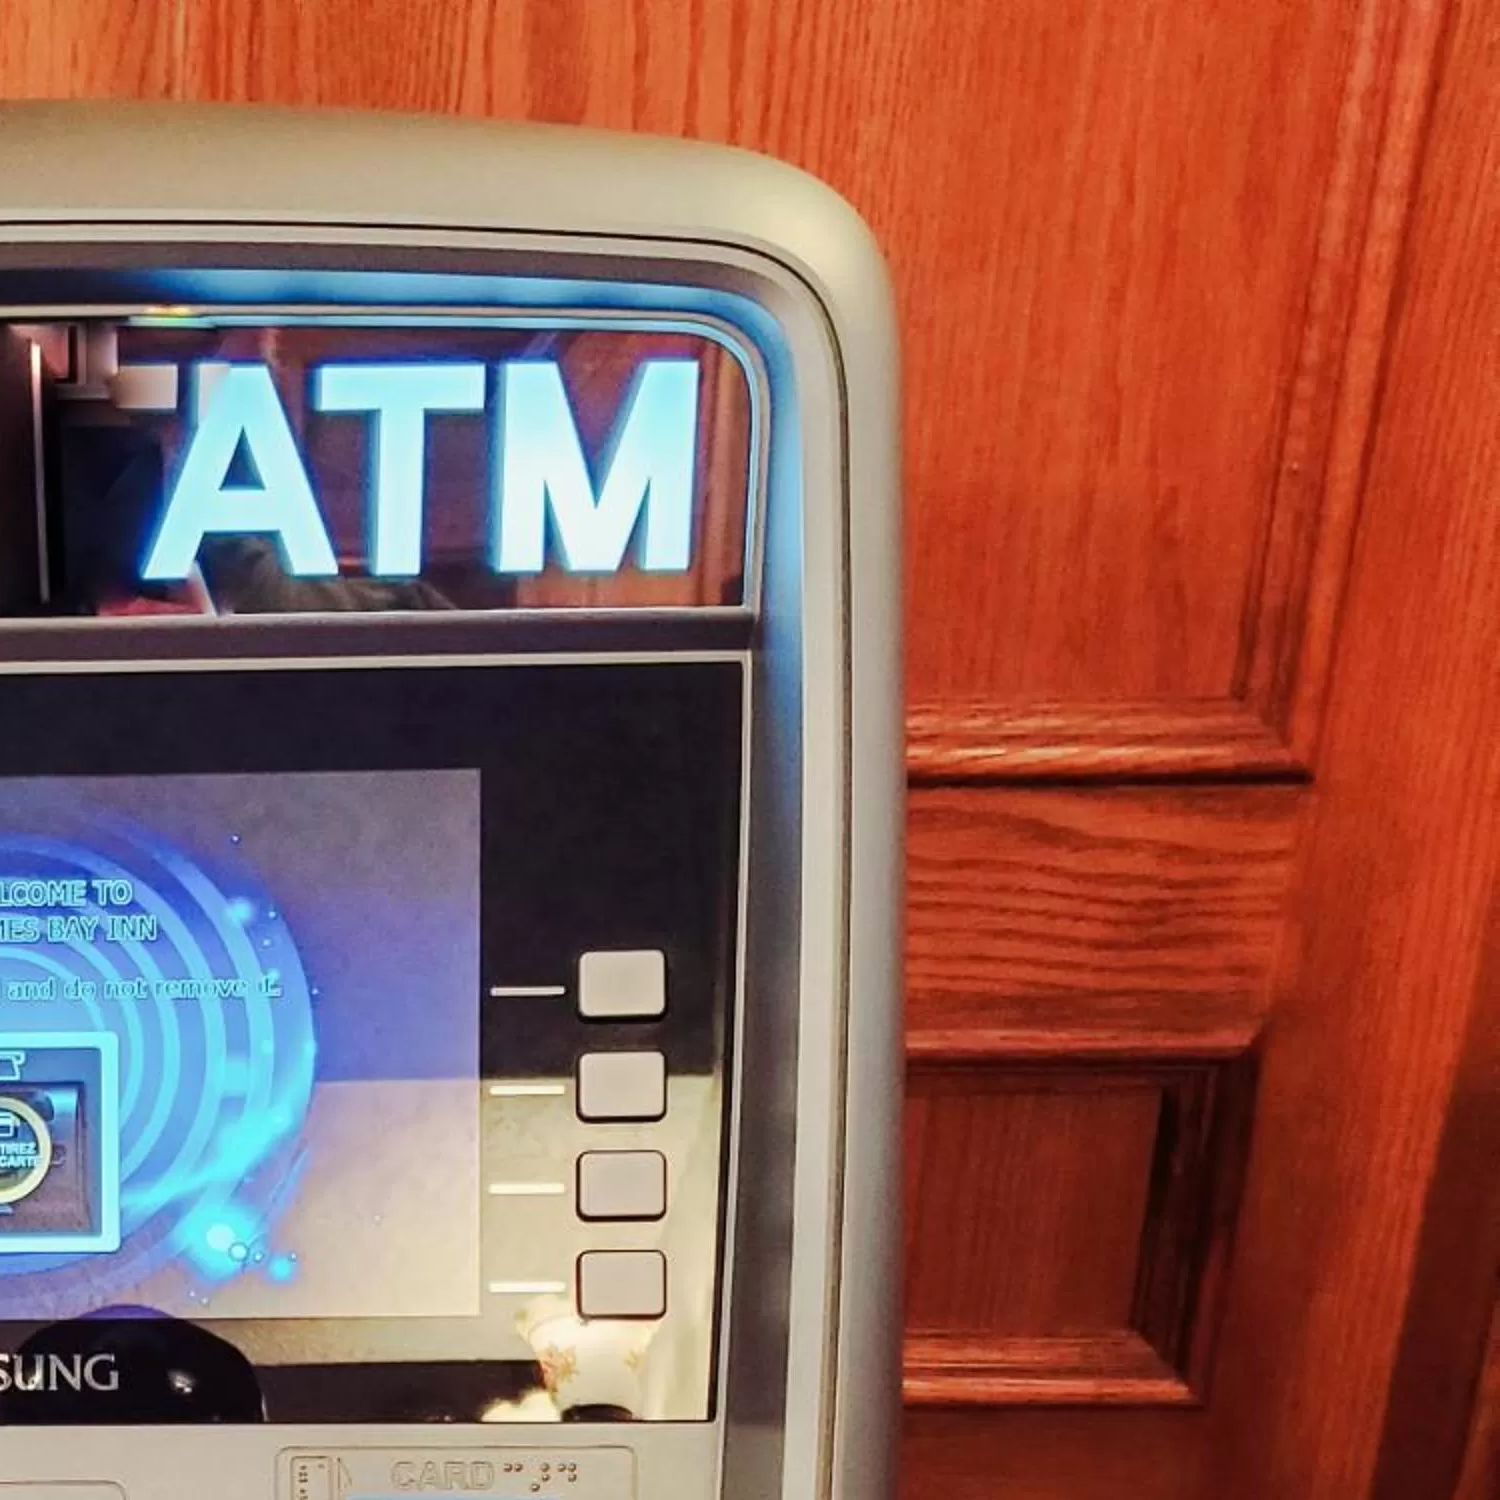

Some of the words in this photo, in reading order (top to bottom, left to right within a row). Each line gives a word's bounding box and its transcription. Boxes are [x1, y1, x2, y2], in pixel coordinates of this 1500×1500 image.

[139, 360, 700, 580] ATM
[92, 879, 133, 906] TO
[47, 915, 100, 942] BAY
[106, 914, 157, 941] INN
[7, 977, 56, 1001] and
[63, 976, 97, 1001] do
[103, 978, 148, 999] not
[391, 1460, 495, 1491] CARD
